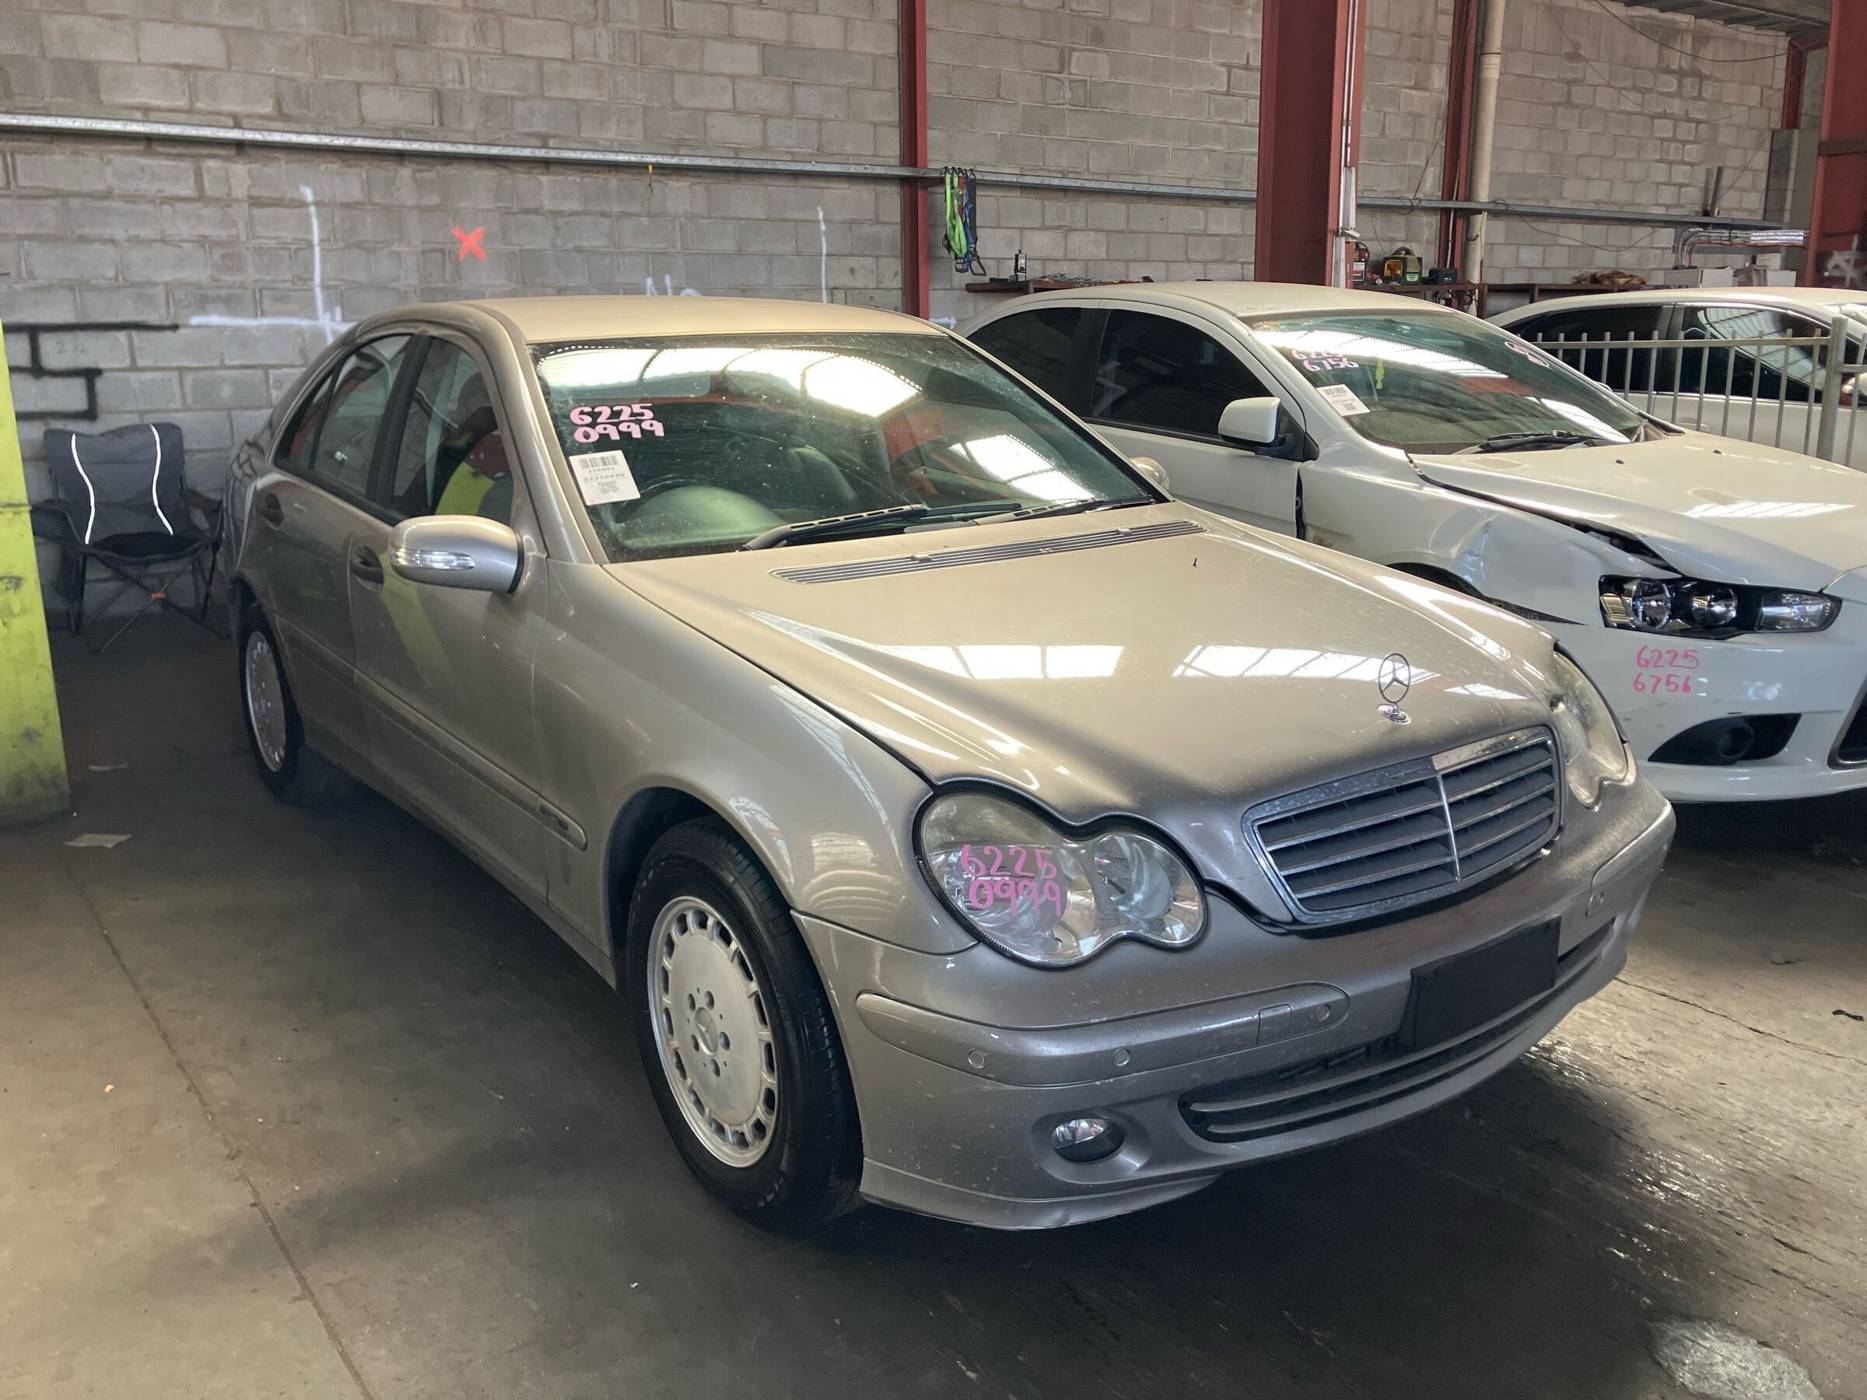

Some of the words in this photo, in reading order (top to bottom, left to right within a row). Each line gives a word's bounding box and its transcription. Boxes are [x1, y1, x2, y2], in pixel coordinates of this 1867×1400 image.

[1303, 358, 1360, 372] 6756
[570, 403, 655, 425] 6225
[574, 419, 665, 443] 0999
[1635, 645, 1700, 670] 6225
[1633, 672, 1692, 694] 6756
[960, 844, 1057, 879] 6225
[969, 878, 1062, 918] 0999
